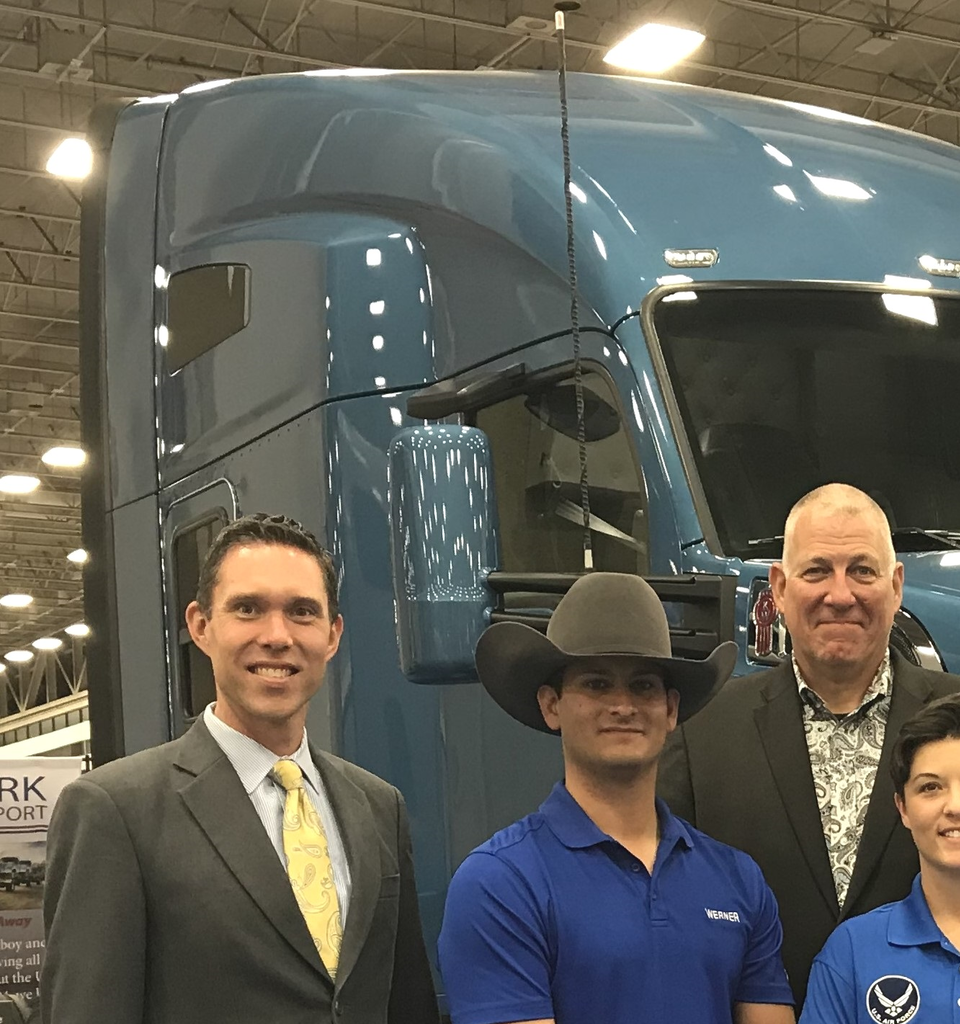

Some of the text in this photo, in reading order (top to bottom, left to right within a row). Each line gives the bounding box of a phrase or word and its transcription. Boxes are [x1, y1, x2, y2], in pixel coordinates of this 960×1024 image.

[704, 908, 740, 922] WERNER
[26, 954, 40, 966] all
[12, 971, 32, 984] the
